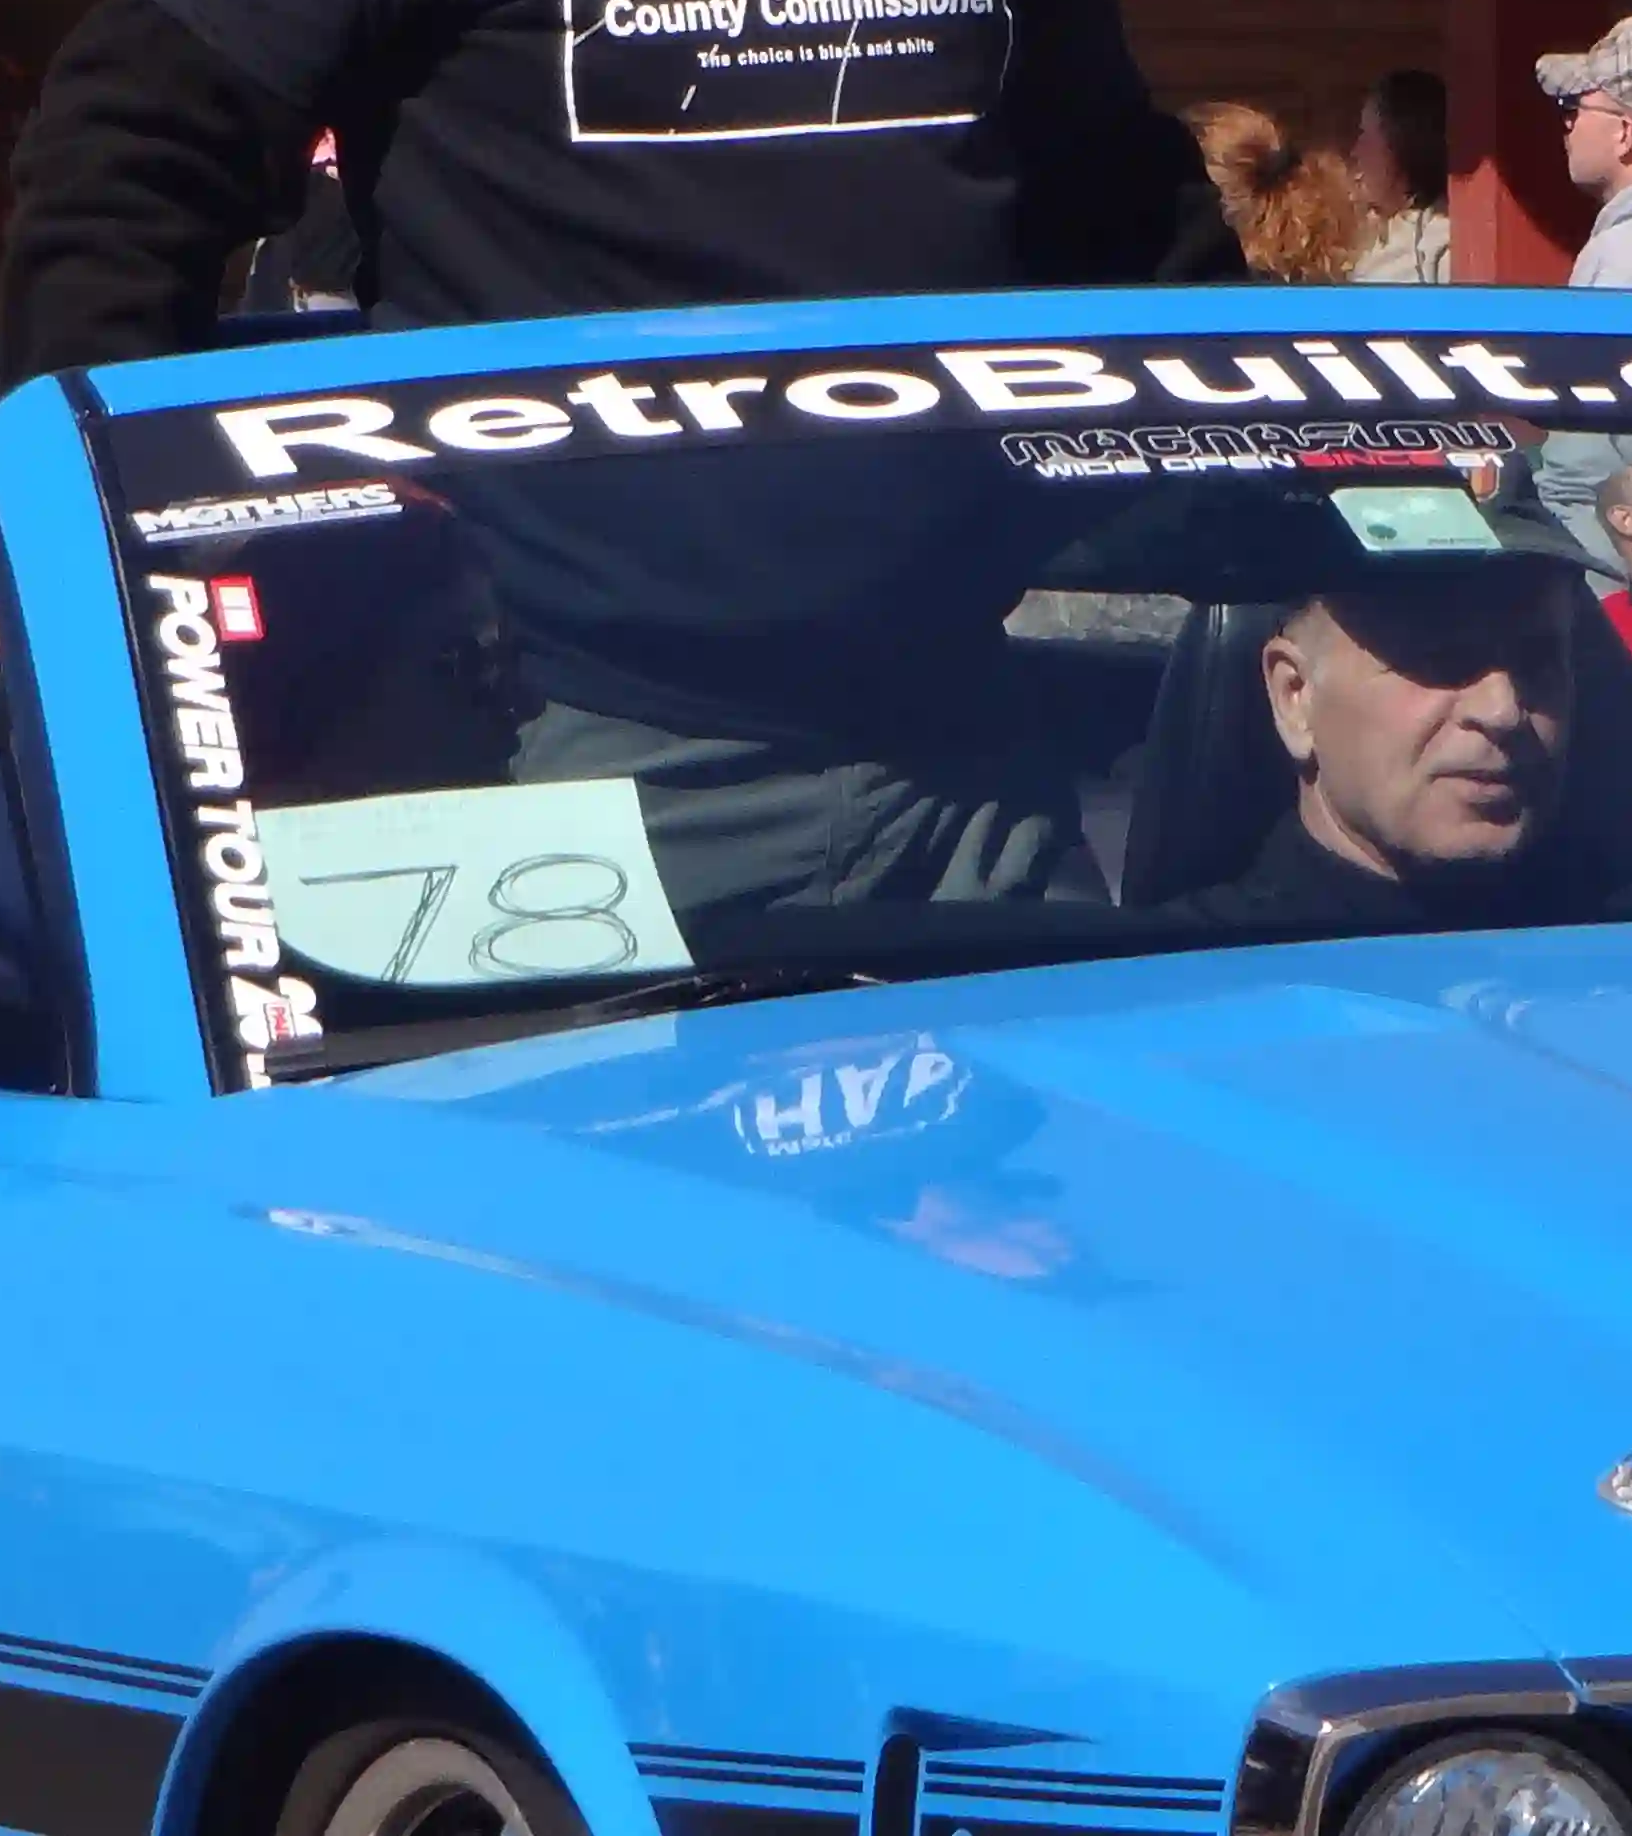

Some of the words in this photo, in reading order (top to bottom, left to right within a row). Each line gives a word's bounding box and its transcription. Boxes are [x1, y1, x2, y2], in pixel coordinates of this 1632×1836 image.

[697, 46, 731, 69] The
[737, 45, 794, 66] choice
[799, 44, 815, 62] is
[818, 43, 862, 60] black
[867, 39, 893, 56] and
[896, 38, 937, 54] white
[1035, 457, 1151, 478] WIDE
[1161, 452, 1297, 472] OPEN
[1298, 449, 1445, 470] SINCE
[132, 483, 397, 533] MOTHERS
[145, 572, 245, 795] POWER
[197, 800, 281, 974] TOUR
[298, 852, 639, 984] 78
